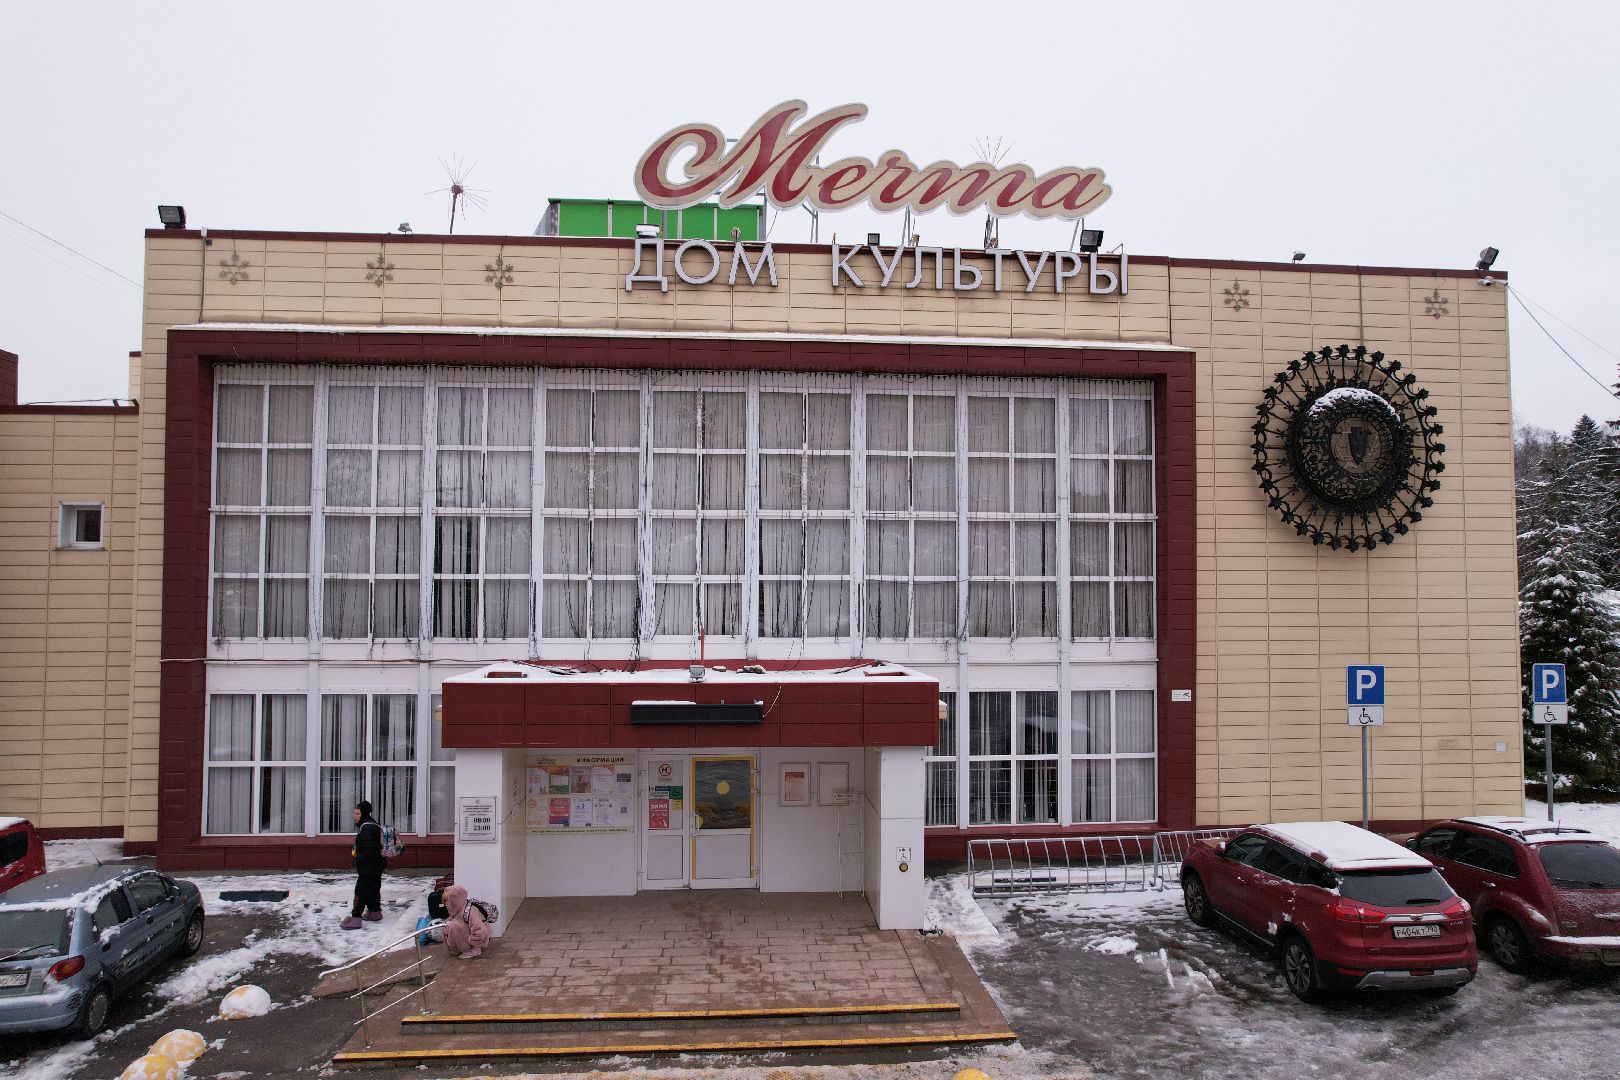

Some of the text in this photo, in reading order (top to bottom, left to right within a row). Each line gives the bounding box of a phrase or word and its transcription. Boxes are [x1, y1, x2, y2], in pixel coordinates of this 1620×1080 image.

[640, 105, 1106, 212] Мечта
[625, 238, 1128, 296] ДОМ КУЛЬТУРЫ
[1356, 669, 1377, 700] P
[1542, 669, 1560, 699] P
